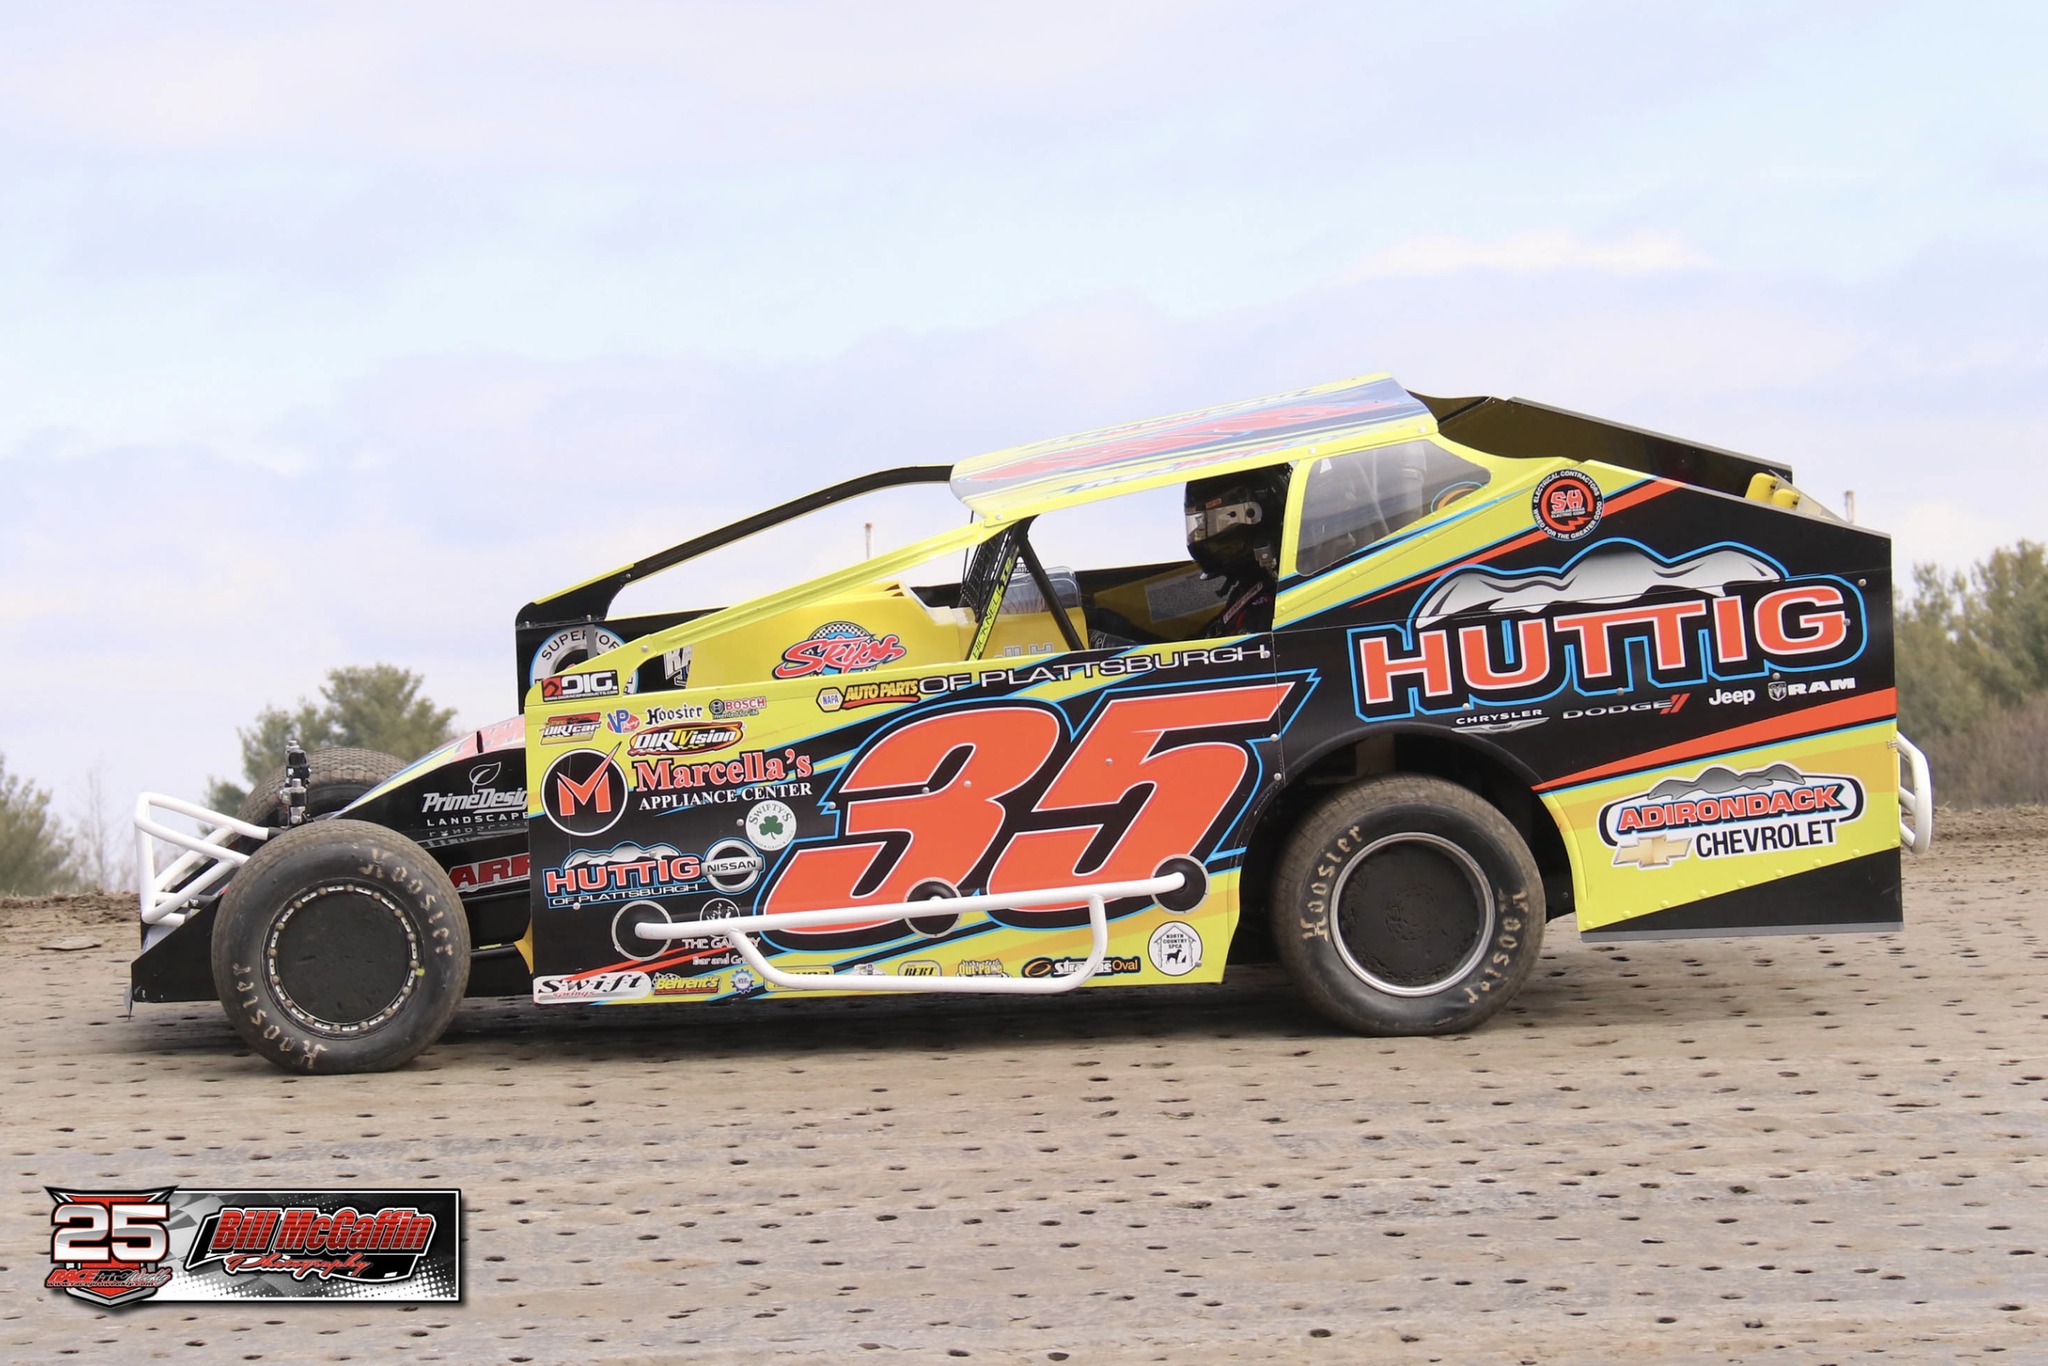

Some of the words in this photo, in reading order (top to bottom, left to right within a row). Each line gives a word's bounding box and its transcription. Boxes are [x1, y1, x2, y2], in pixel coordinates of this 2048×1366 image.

[1533, 472, 1560, 503] ELECTRICAL
[1560, 470, 1600, 497] CONTRACTORS
[1550, 489, 1584, 511] SH
[1570, 521, 1597, 539] GREATER
[541, 629, 620, 661] SUPEOR
[1358, 584, 1847, 706] HUTTIG
[918, 672, 970, 694] OF
[980, 644, 1266, 688] PLATTSBURGH
[822, 694, 840, 704] NAPA
[844, 686, 879, 702] AUTO
[879, 679, 919, 699] PARTS
[1708, 689, 1756, 706] Jeep
[1788, 677, 1856, 696] RAM
[645, 704, 703, 725] Hoosier
[725, 697, 766, 711] BOSCH
[1562, 699, 1673, 720] DODGE
[607, 709, 630, 733] VP
[1455, 708, 1543, 725] CHRYSLER
[634, 749, 813, 792] Marcella's
[638, 789, 738, 811] APPLIANCE
[741, 783, 813, 800] CENTER
[764, 681, 1296, 934] 35
[1617, 783, 1841, 833] ADIRONDACK
[427, 812, 528, 827] LANDSCAPE
[748, 803, 792, 825] SWIFTY'S
[1695, 818, 1837, 858] CHEVROLET
[546, 856, 700, 893] HUTTIG
[706, 859, 757, 872] NISSAN
[552, 897, 577, 906] OF
[583, 883, 699, 903] PLATTSBURGH
[1300, 825, 1363, 942] Hoosier
[681, 938, 709, 949] THE
[693, 956, 710, 965] Bar
[711, 953, 730, 965] and
[656, 975, 719, 989] Behrent's
